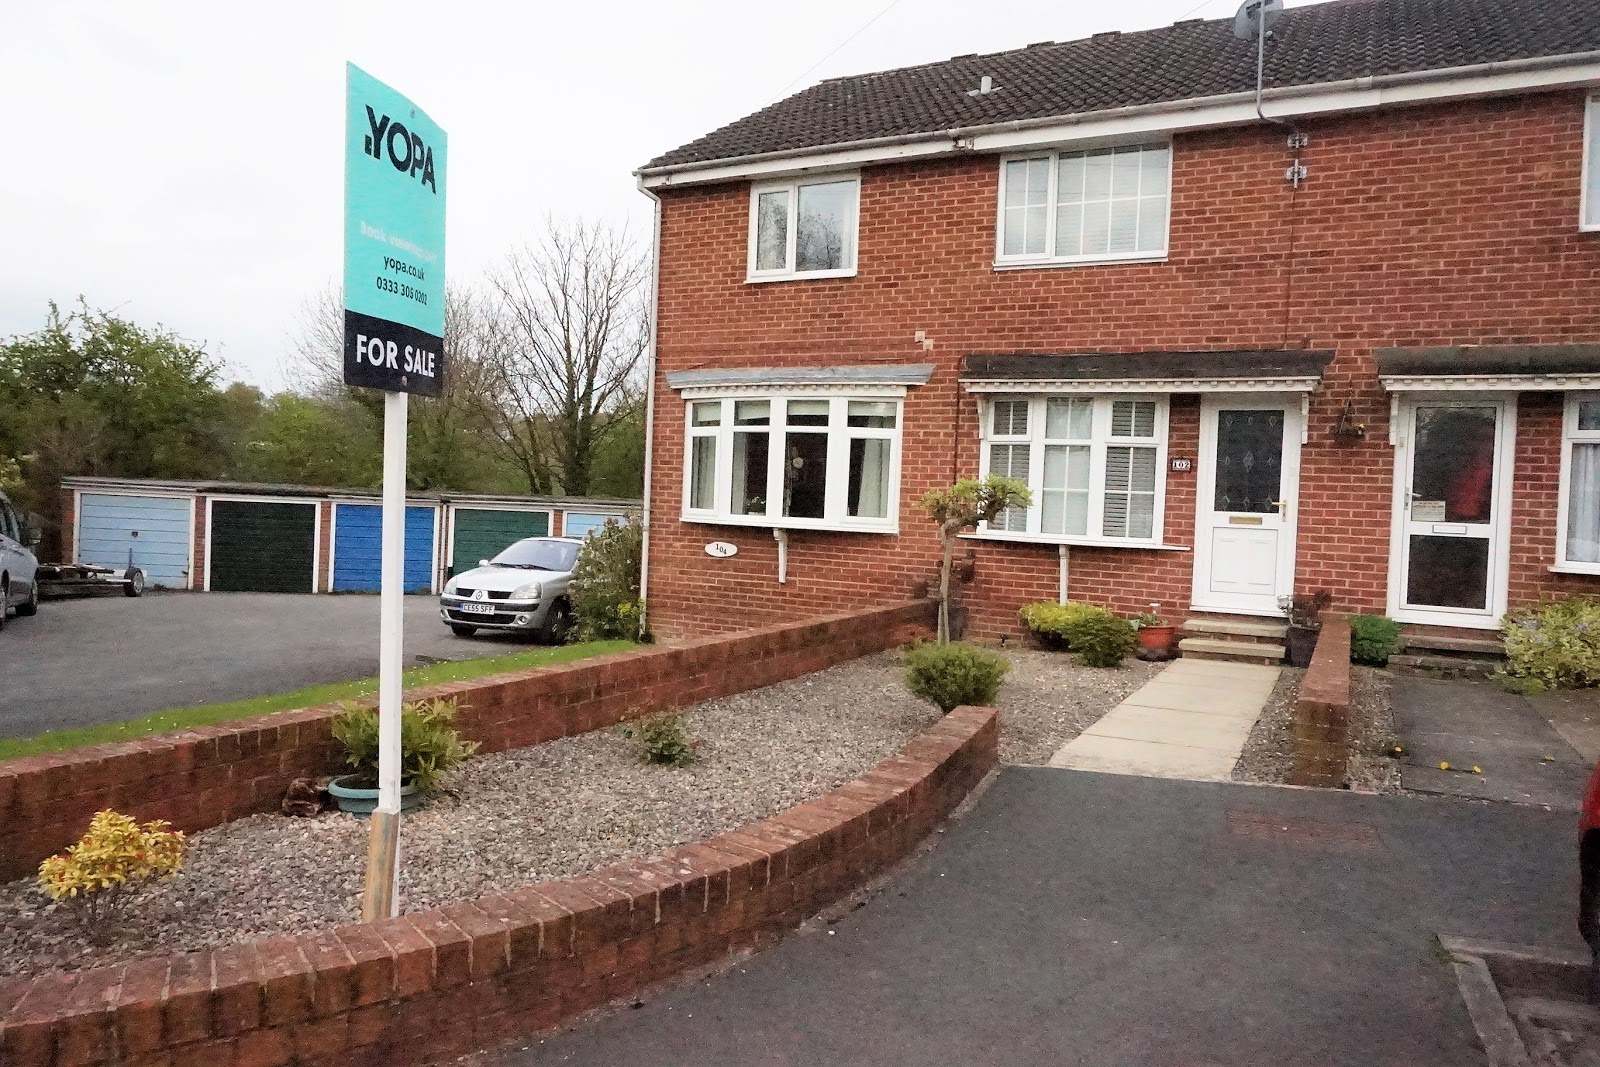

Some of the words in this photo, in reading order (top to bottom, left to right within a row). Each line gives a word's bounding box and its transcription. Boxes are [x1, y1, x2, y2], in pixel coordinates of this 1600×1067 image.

[365, 103, 437, 195] YOPA
[383, 255, 425, 281] yopa.co.uk
[376, 276, 398, 294] 0333
[400, 283, 414, 300] 305
[414, 289, 428, 306] 0202
[356, 333, 399, 370] FOR
[403, 344, 435, 378] SALE
[715, 543, 727, 555] 104
